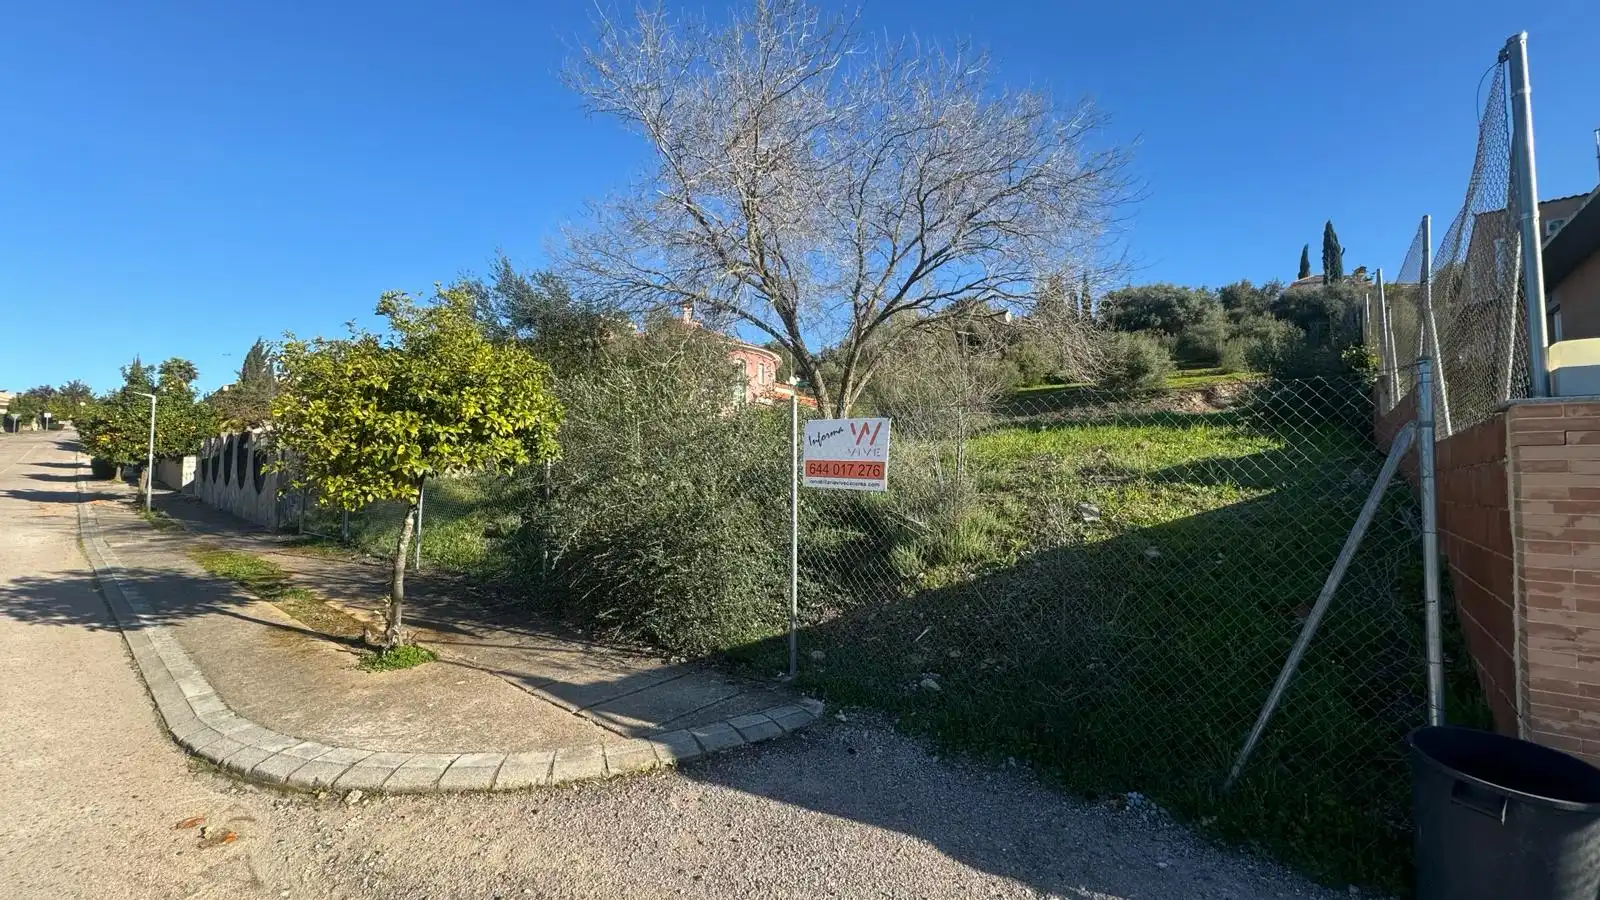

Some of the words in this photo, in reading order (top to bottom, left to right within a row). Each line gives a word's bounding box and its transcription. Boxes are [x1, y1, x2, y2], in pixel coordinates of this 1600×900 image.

[808, 427, 844, 447] Informa
[848, 448, 881, 457] VIVE
[809, 463, 829, 475] 644
[833, 463, 854, 476] 017
[858, 464, 881, 477] 276
